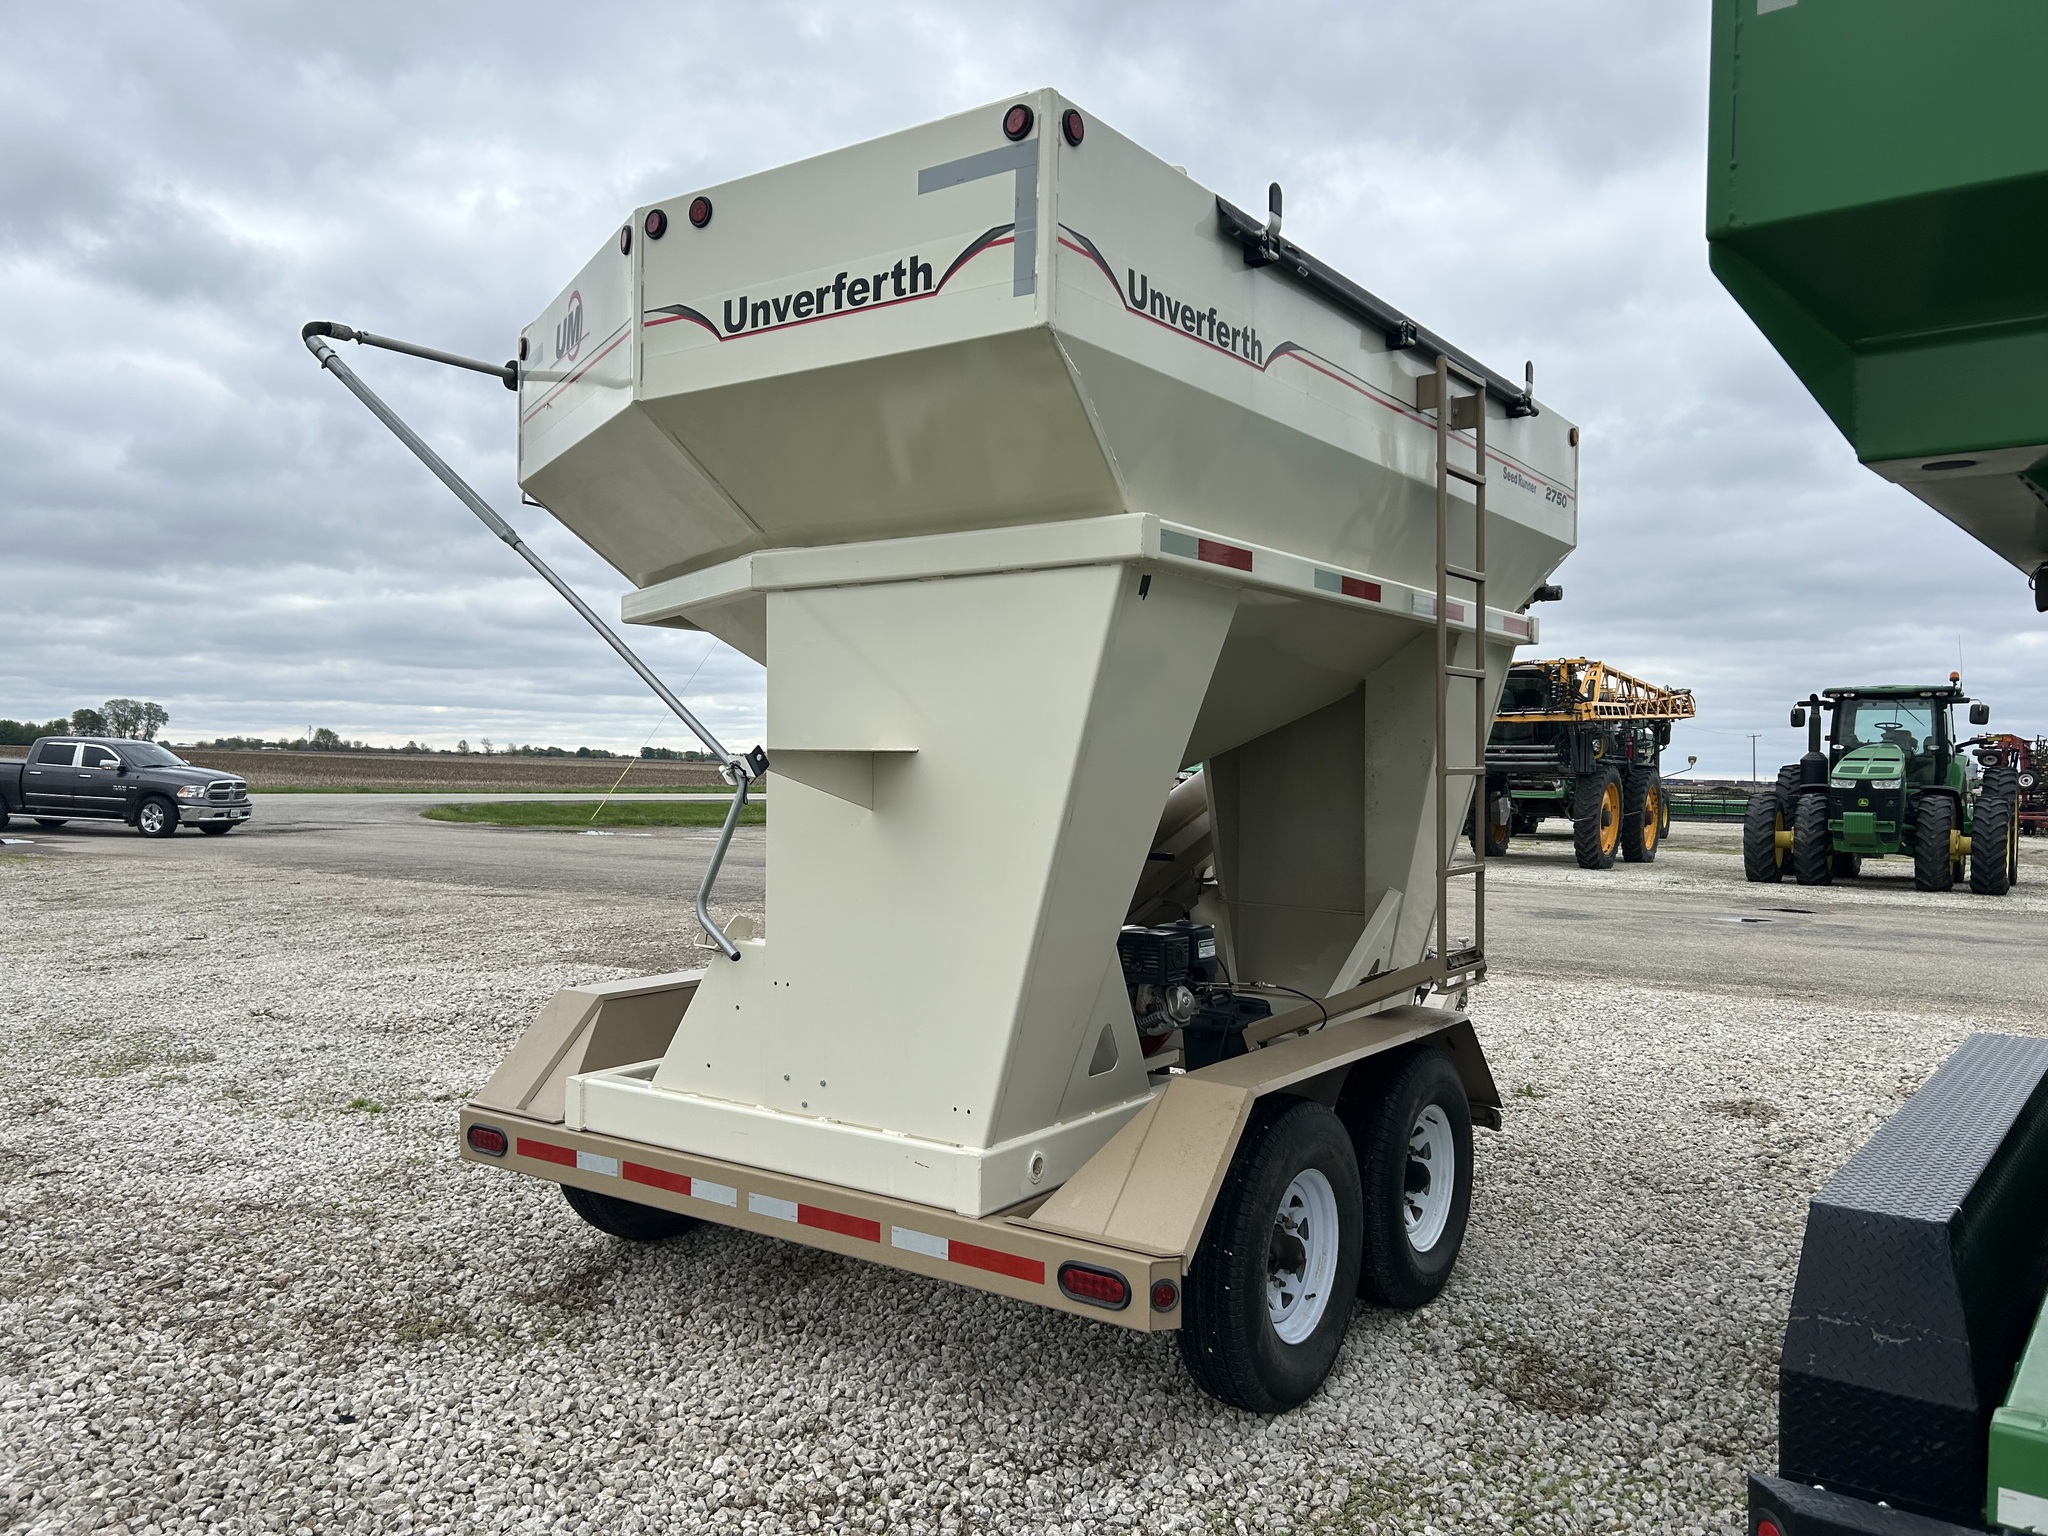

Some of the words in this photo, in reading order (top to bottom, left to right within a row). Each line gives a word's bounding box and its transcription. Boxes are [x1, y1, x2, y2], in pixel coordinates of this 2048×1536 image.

[723, 255, 933, 333] Unverferth
[1128, 268, 1263, 365] Unverferth
[555, 303, 581, 360] UM
[1502, 466, 1518, 485] Seed
[1518, 473, 1537, 495] Runner
[1545, 486, 1568, 508] 2750
